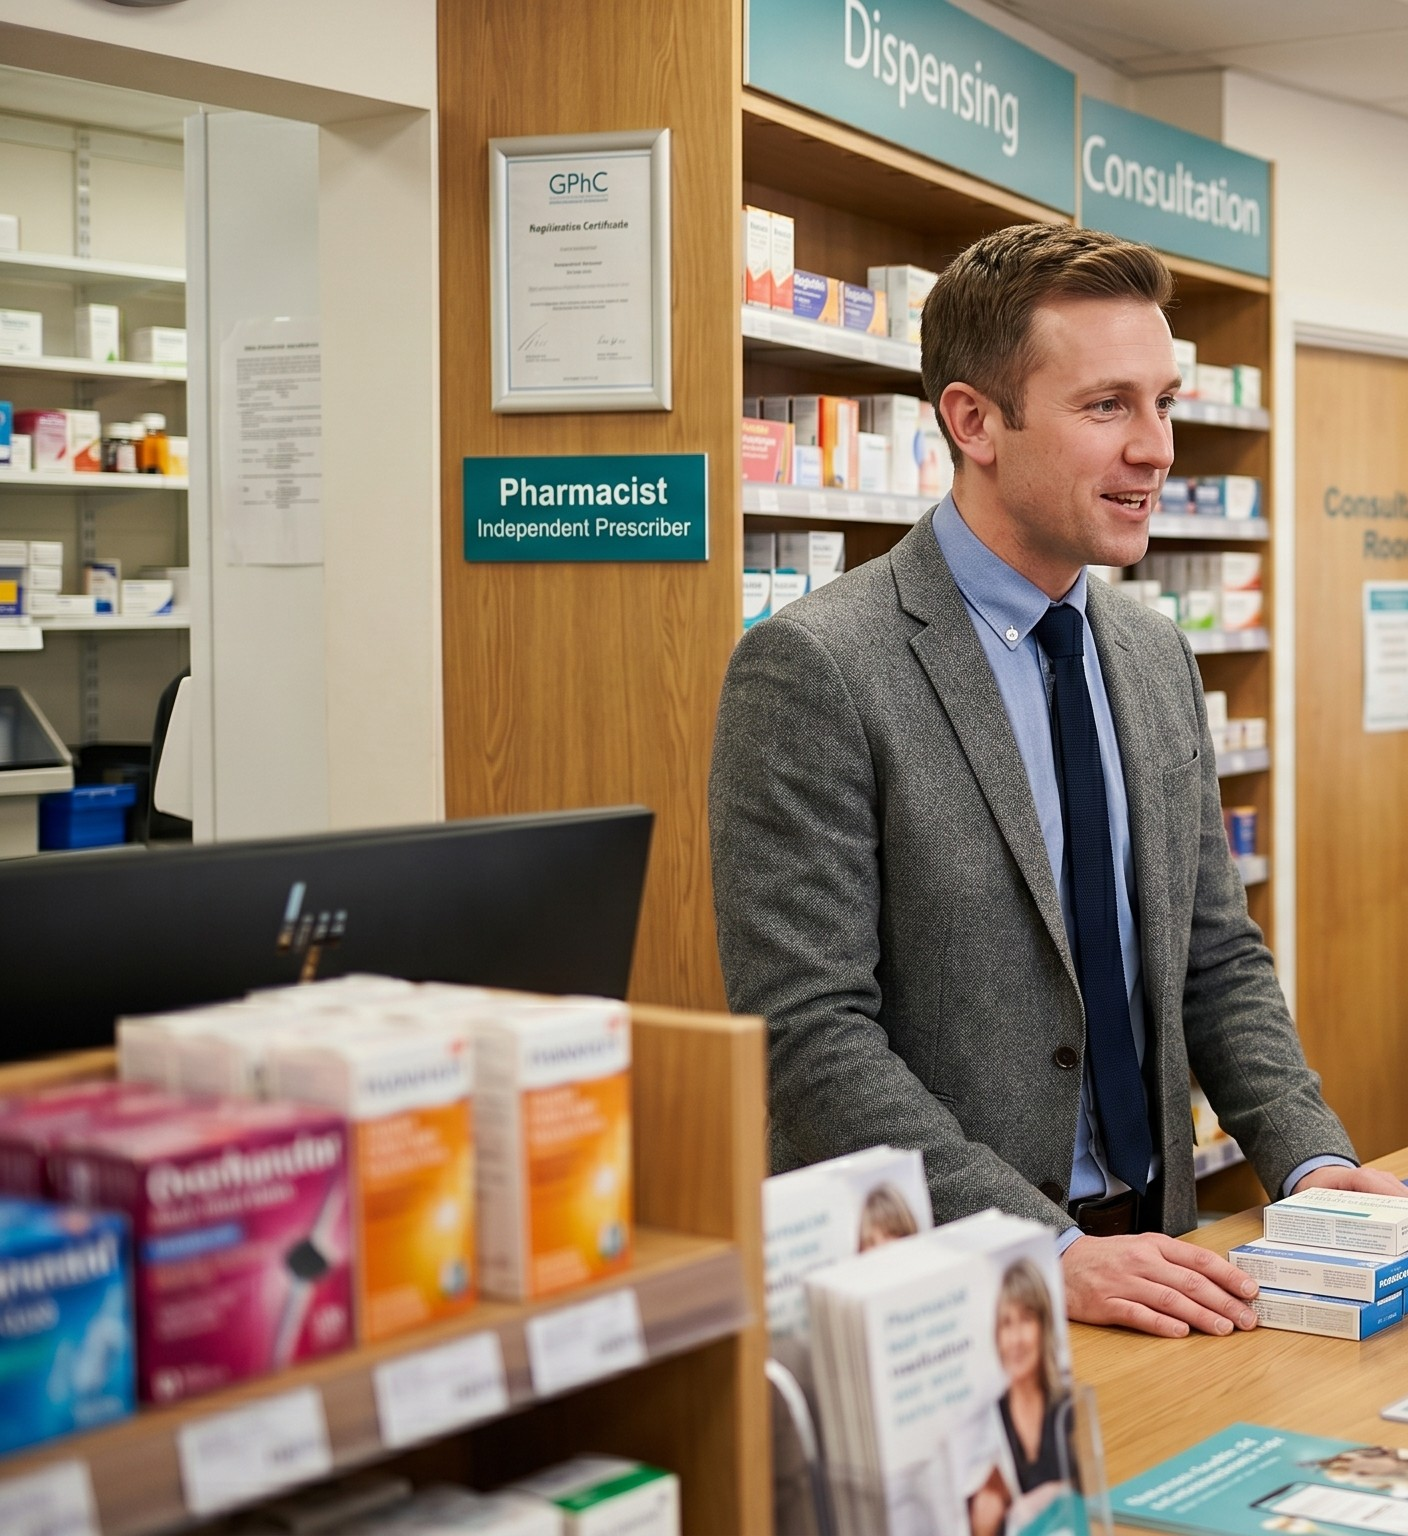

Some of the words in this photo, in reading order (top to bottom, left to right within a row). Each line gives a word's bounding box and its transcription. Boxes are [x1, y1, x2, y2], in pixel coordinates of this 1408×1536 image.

[843, 0, 1019, 157] Dispensing
[548, 171, 609, 195] GPhC
[1081, 135, 1260, 237] Consultation
[499, 475, 668, 507] Pharmacist
[477, 518, 590, 542] Independent
[595, 517, 691, 537] Prescriber
